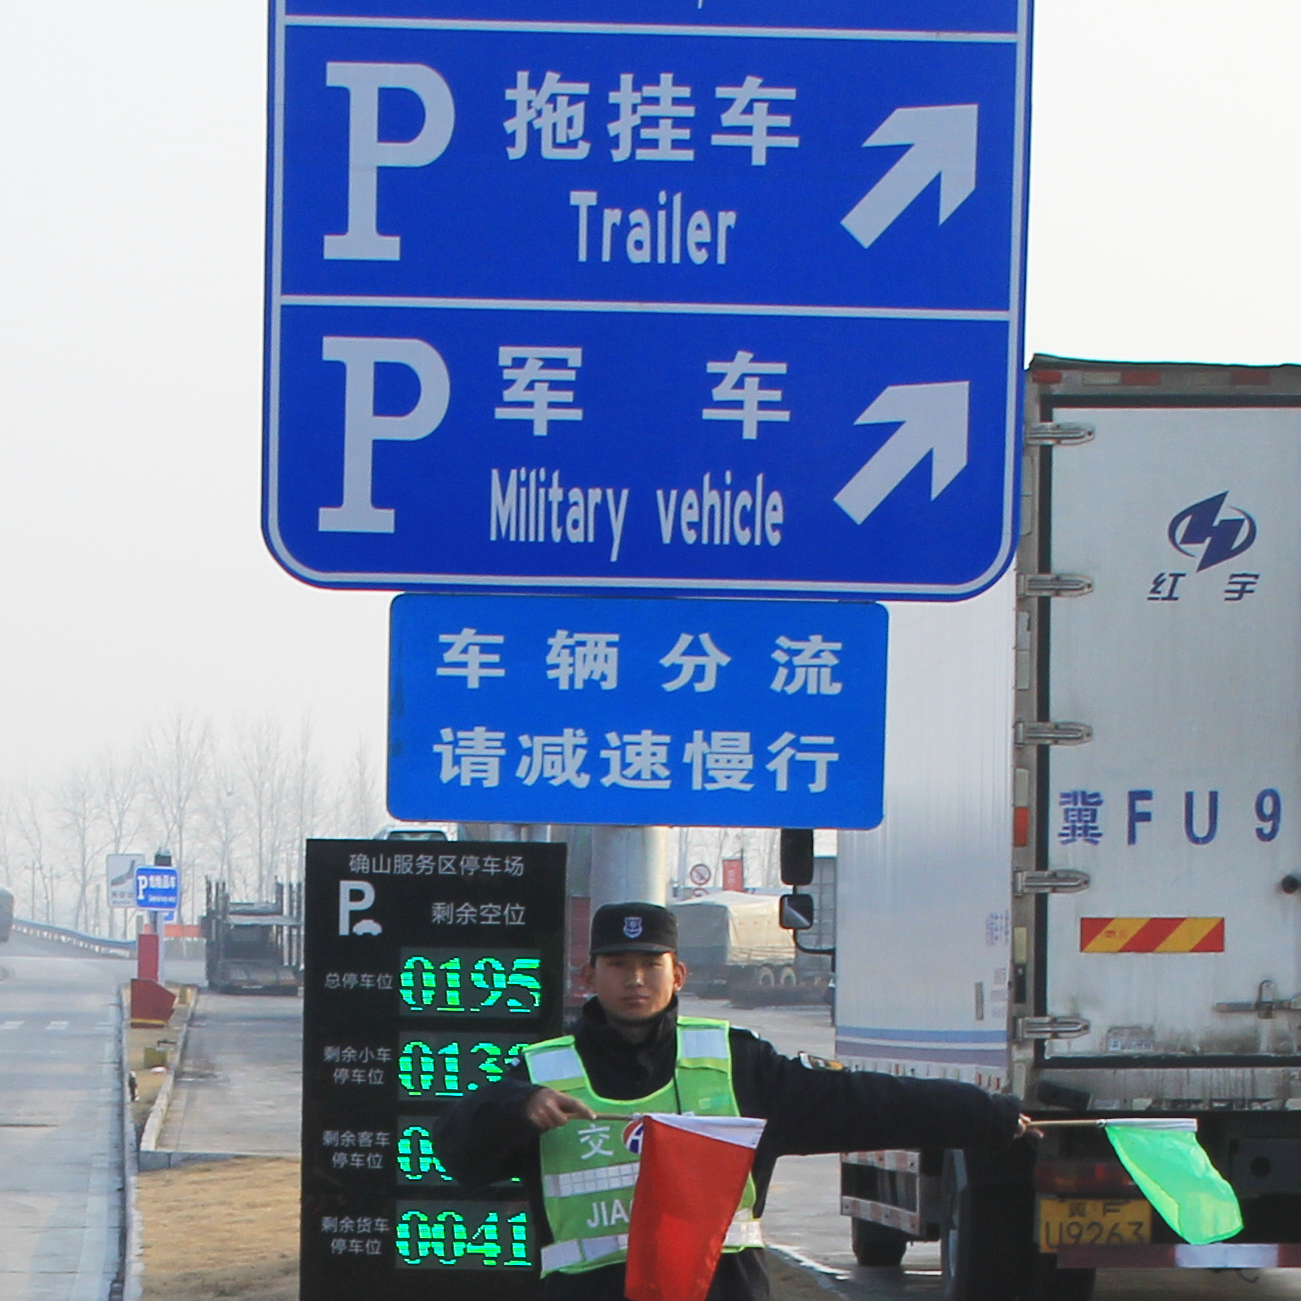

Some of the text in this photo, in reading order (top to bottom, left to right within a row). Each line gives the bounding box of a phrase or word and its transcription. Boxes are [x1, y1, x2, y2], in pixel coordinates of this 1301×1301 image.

[503, 70, 799, 166] 拖挂车
[323, 61, 456, 261] P
[570, 191, 736, 265] Trailer
[317, 335, 451, 533] P
[489, 468, 784, 562] Military vehicle
[1147, 573, 1260, 601] 红宇
[435, 628, 843, 695] 车辆分流
[432, 726, 840, 793] 请减速慢行
[349, 853, 525, 877] 确山服务区停车场
[431, 902, 526, 926] 剩余空位
[324, 972, 393, 991] 总停车位
[399, 956, 541, 1013] 0195
[323, 1046, 393, 1064] 剩余小车
[332, 1067, 384, 1086] 停车位
[322, 1130, 391, 1148] 剩余客车
[577, 1124, 614, 1160] 交
[331, 1151, 383, 1170] 停车位
[321, 1216, 389, 1234] 剩余货车
[586, 1199, 634, 1229] JIA
[330, 1237, 382, 1256] 停车位
[396, 1211, 532, 1265] 0041
